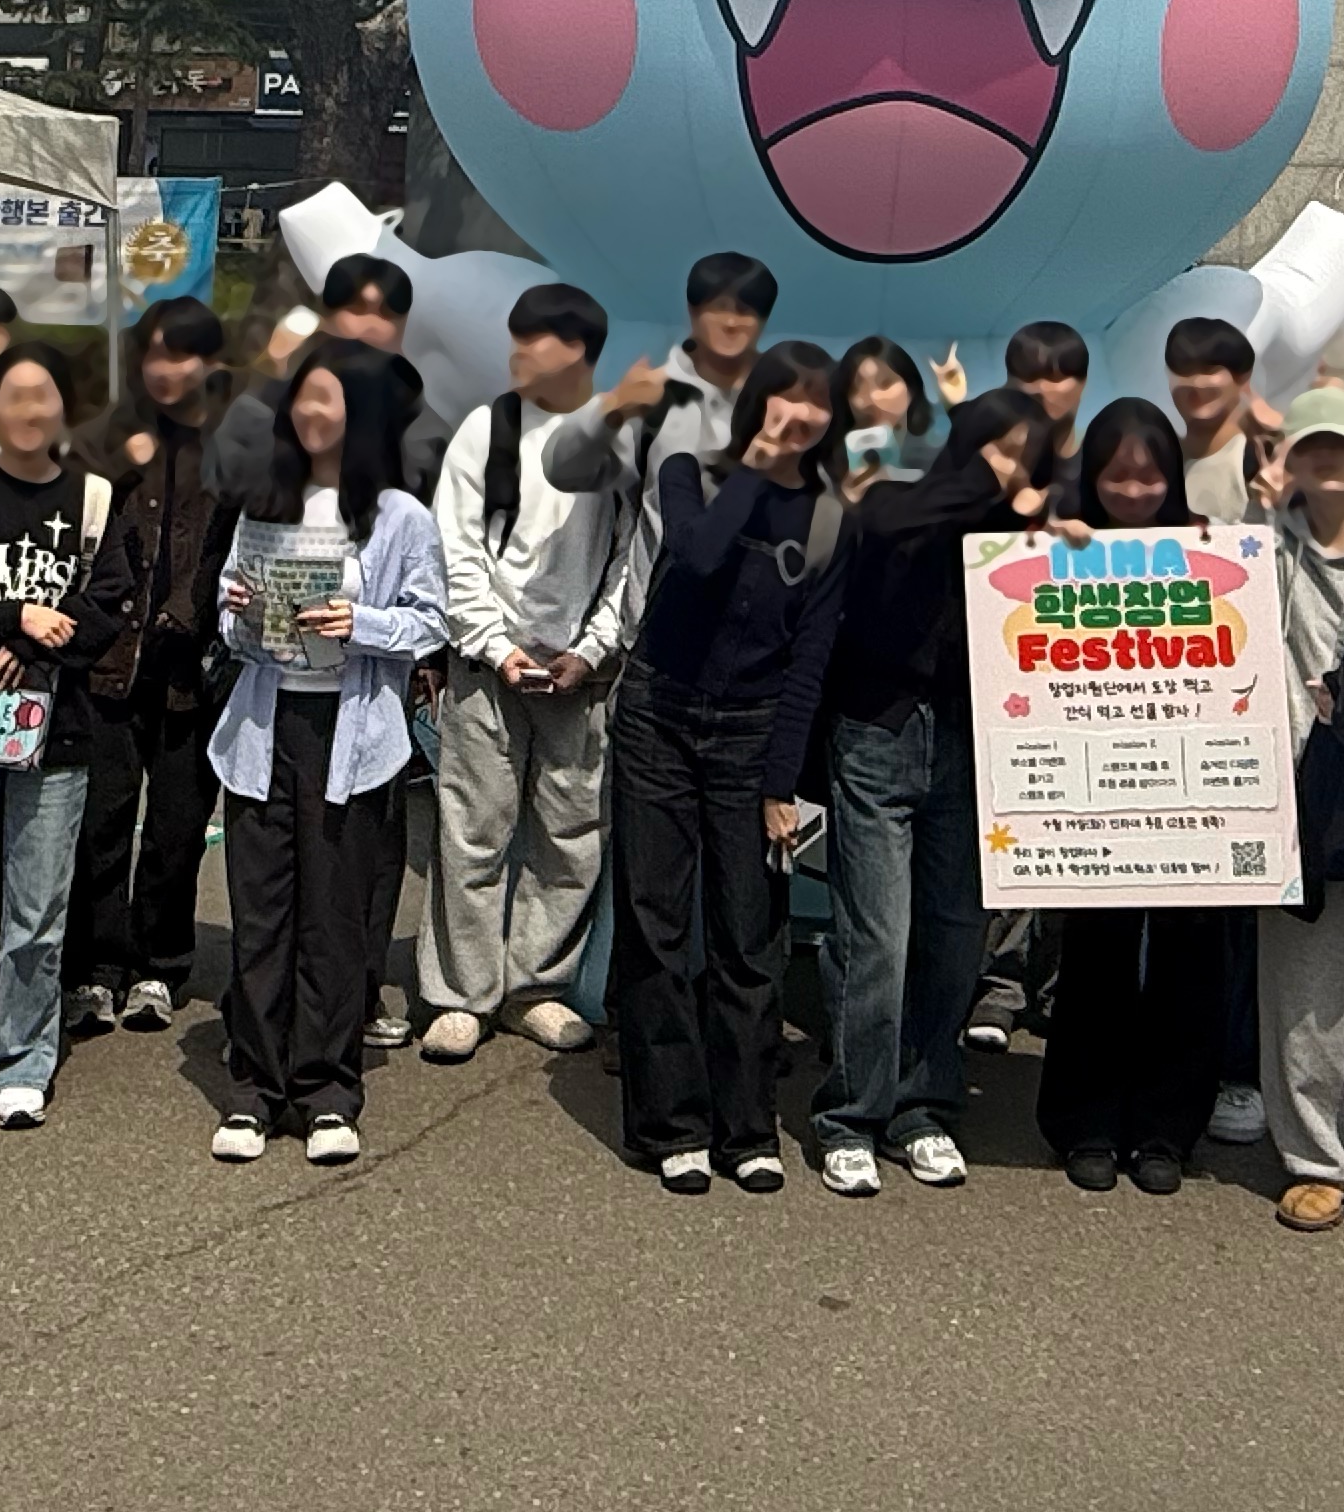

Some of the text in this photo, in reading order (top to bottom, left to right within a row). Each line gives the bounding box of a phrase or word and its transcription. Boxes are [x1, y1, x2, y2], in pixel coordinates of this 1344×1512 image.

[264, 73, 302, 95] PA
[1050, 538, 1189, 580] INHA
[1034, 580, 1213, 629] 학생창업
[1017, 625, 1236, 672] Festival
[1049, 681, 1147, 698] 창업지원단에서
